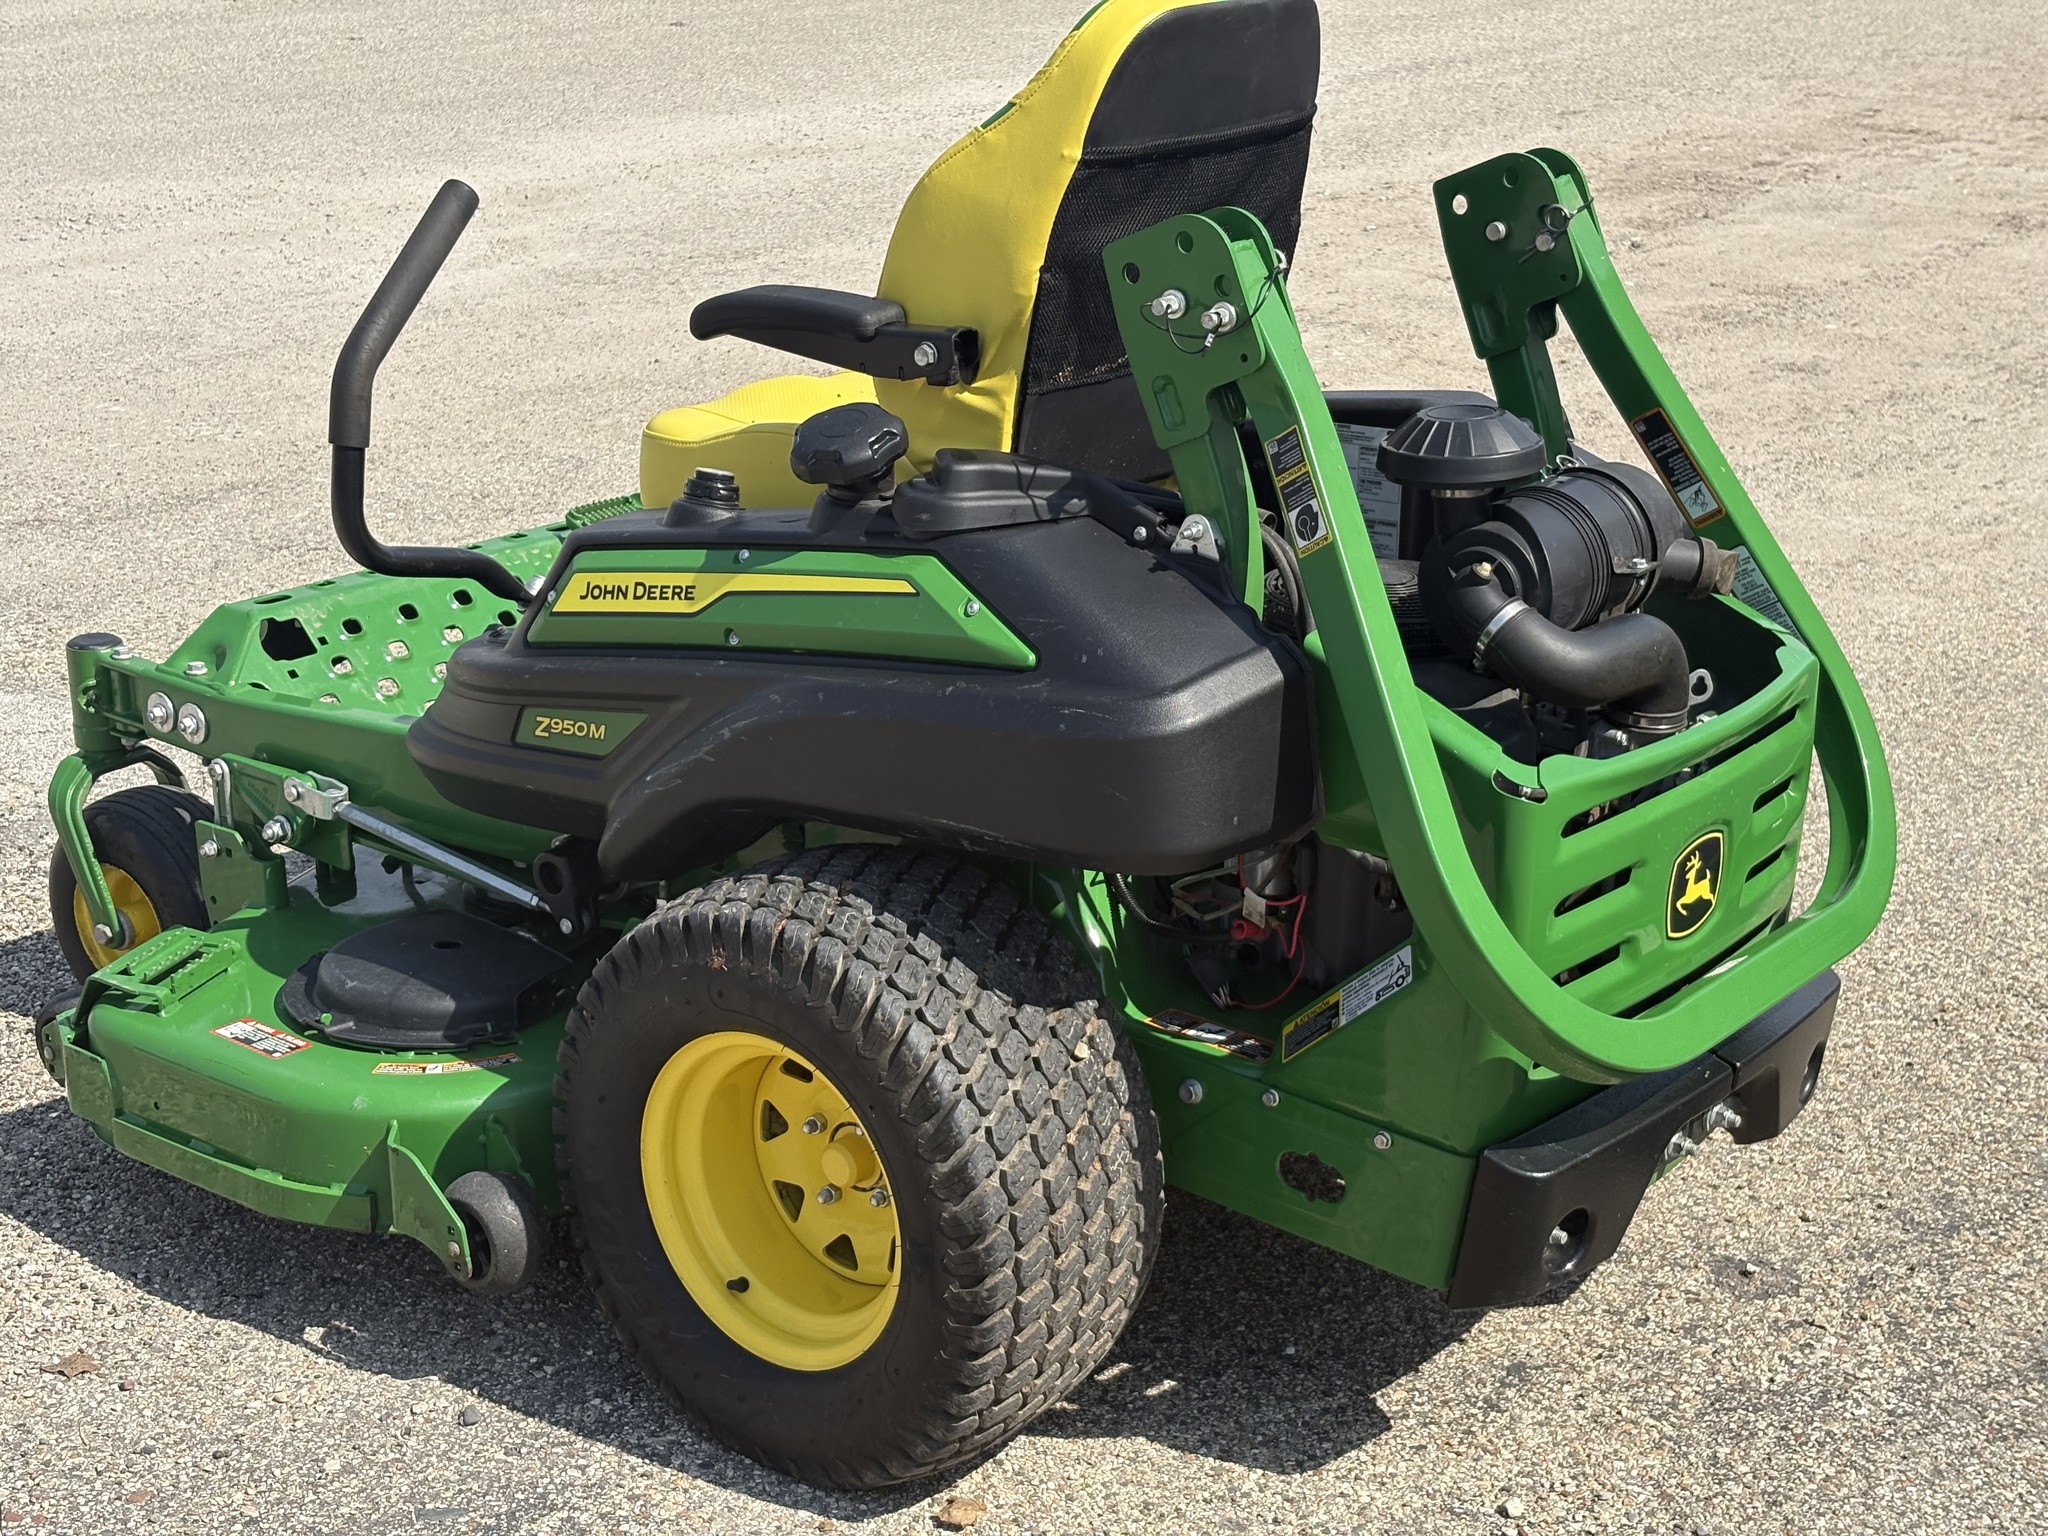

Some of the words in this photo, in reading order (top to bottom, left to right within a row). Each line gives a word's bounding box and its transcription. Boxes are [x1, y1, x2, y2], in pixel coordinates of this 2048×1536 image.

[1300, 538, 1324, 556] CAUTION
[579, 581, 629, 601] JOHN
[633, 581, 696, 601] DEERE
[1299, 998, 1330, 1024] ATENCIÓN
